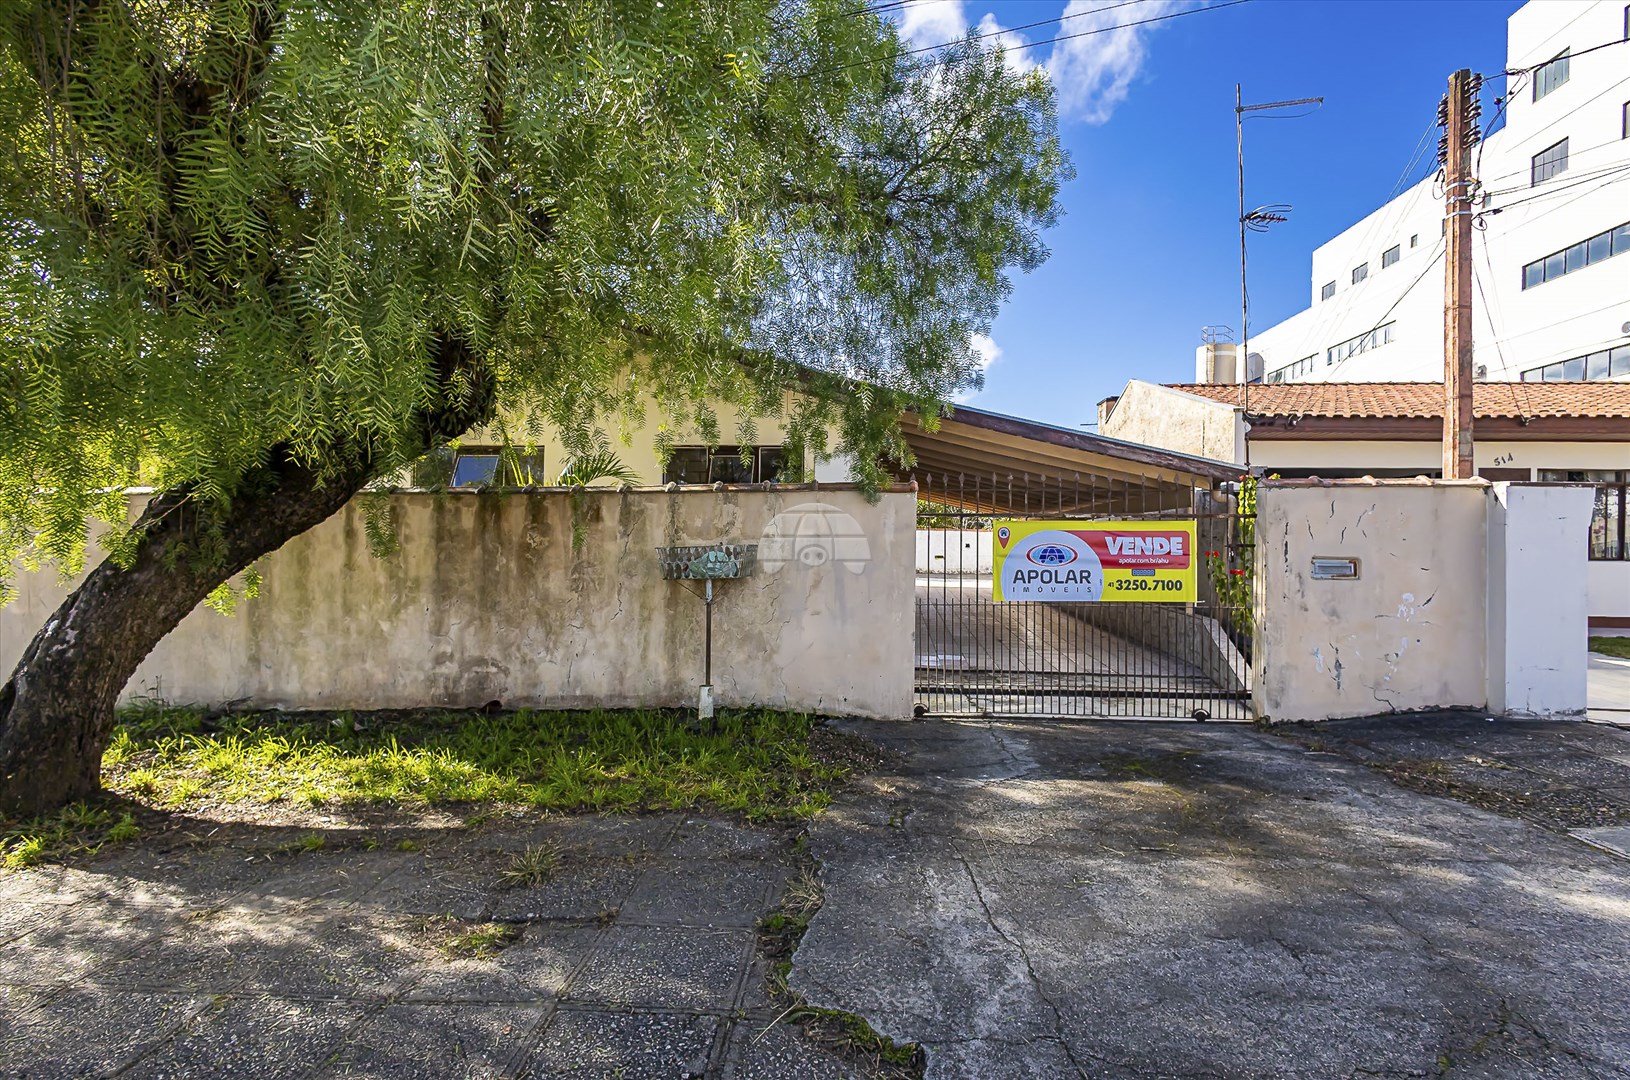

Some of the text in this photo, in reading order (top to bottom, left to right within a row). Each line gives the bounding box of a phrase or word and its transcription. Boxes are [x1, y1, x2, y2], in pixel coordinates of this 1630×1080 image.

[1104, 536, 1183, 556] VENDE
[1012, 569, 1092, 584] APOLAR
[1115, 579, 1183, 591] 3250.7100
